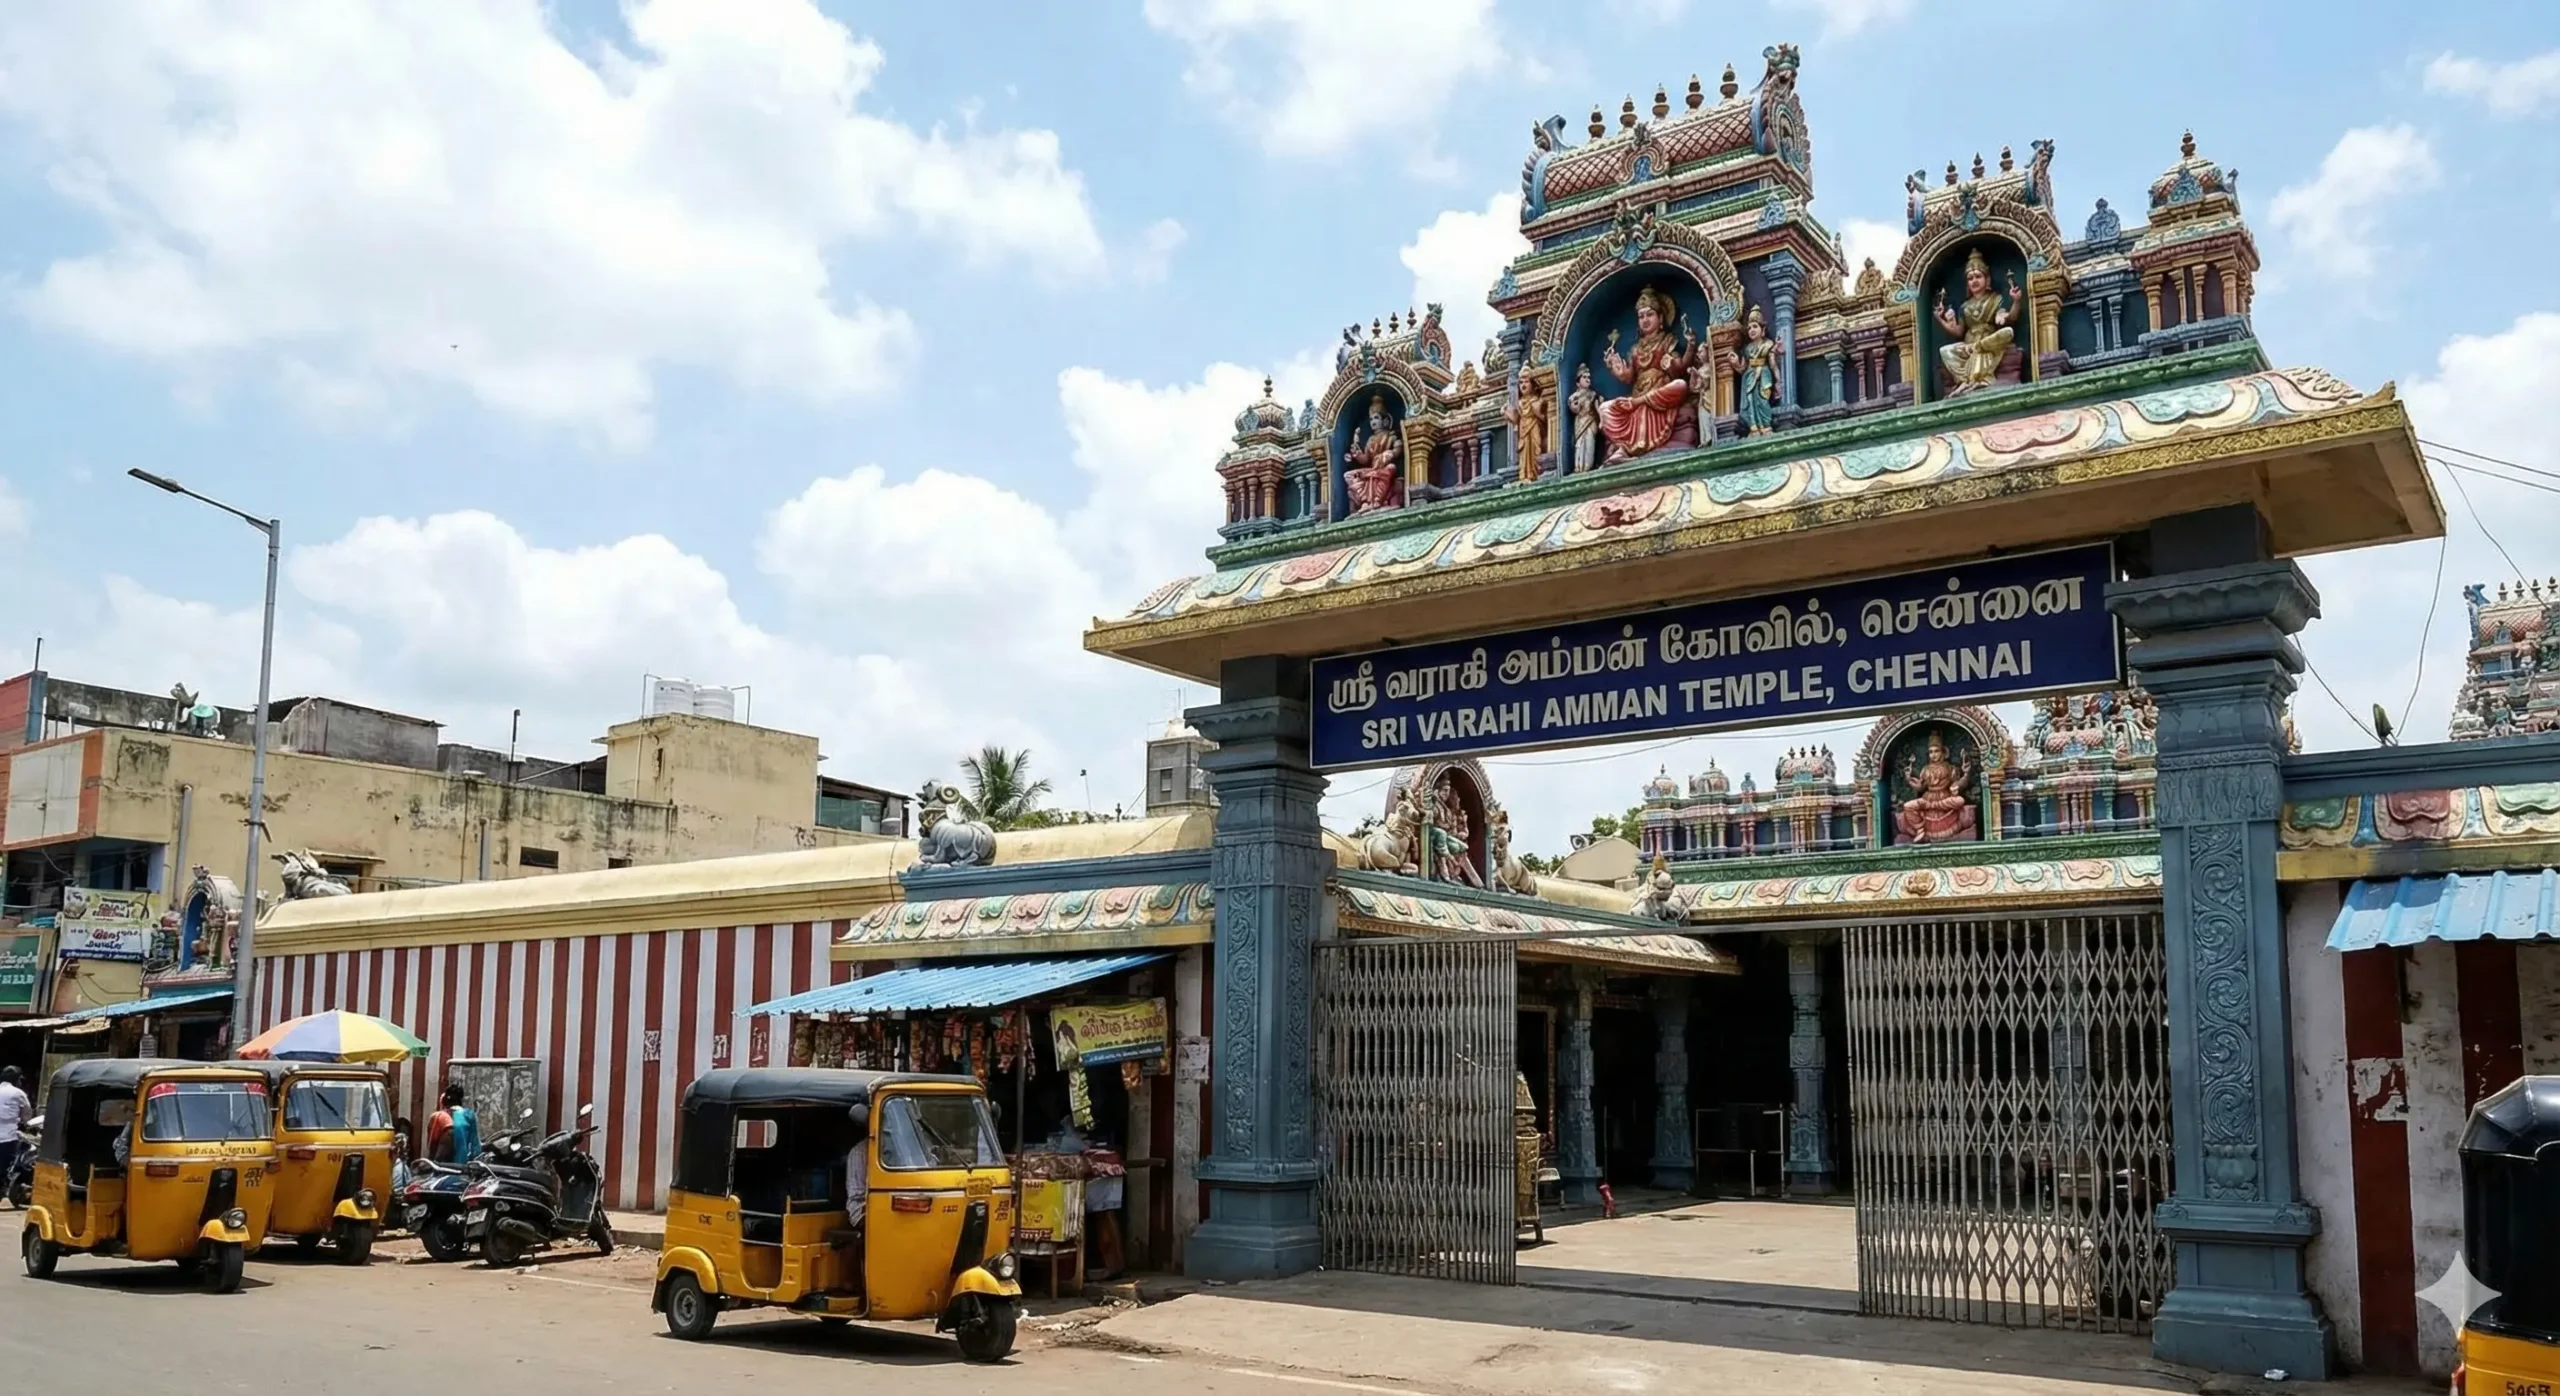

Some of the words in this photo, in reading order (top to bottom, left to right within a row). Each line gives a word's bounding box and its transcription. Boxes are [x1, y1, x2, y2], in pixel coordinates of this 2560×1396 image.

[1361, 715, 1408, 750] SRI
[1416, 700, 1531, 743] VARAHI
[1541, 684, 1668, 730] AMMAN
[1678, 665, 1835, 712] TEMPLE,
[1847, 640, 2033, 695] CHENNAI
[1385, 647, 1488, 702] வராகி
[1498, 624, 1648, 686] அம்மன்
[1660, 598, 1848, 663] கோவில்,
[1861, 576, 2086, 638] சென்னை
